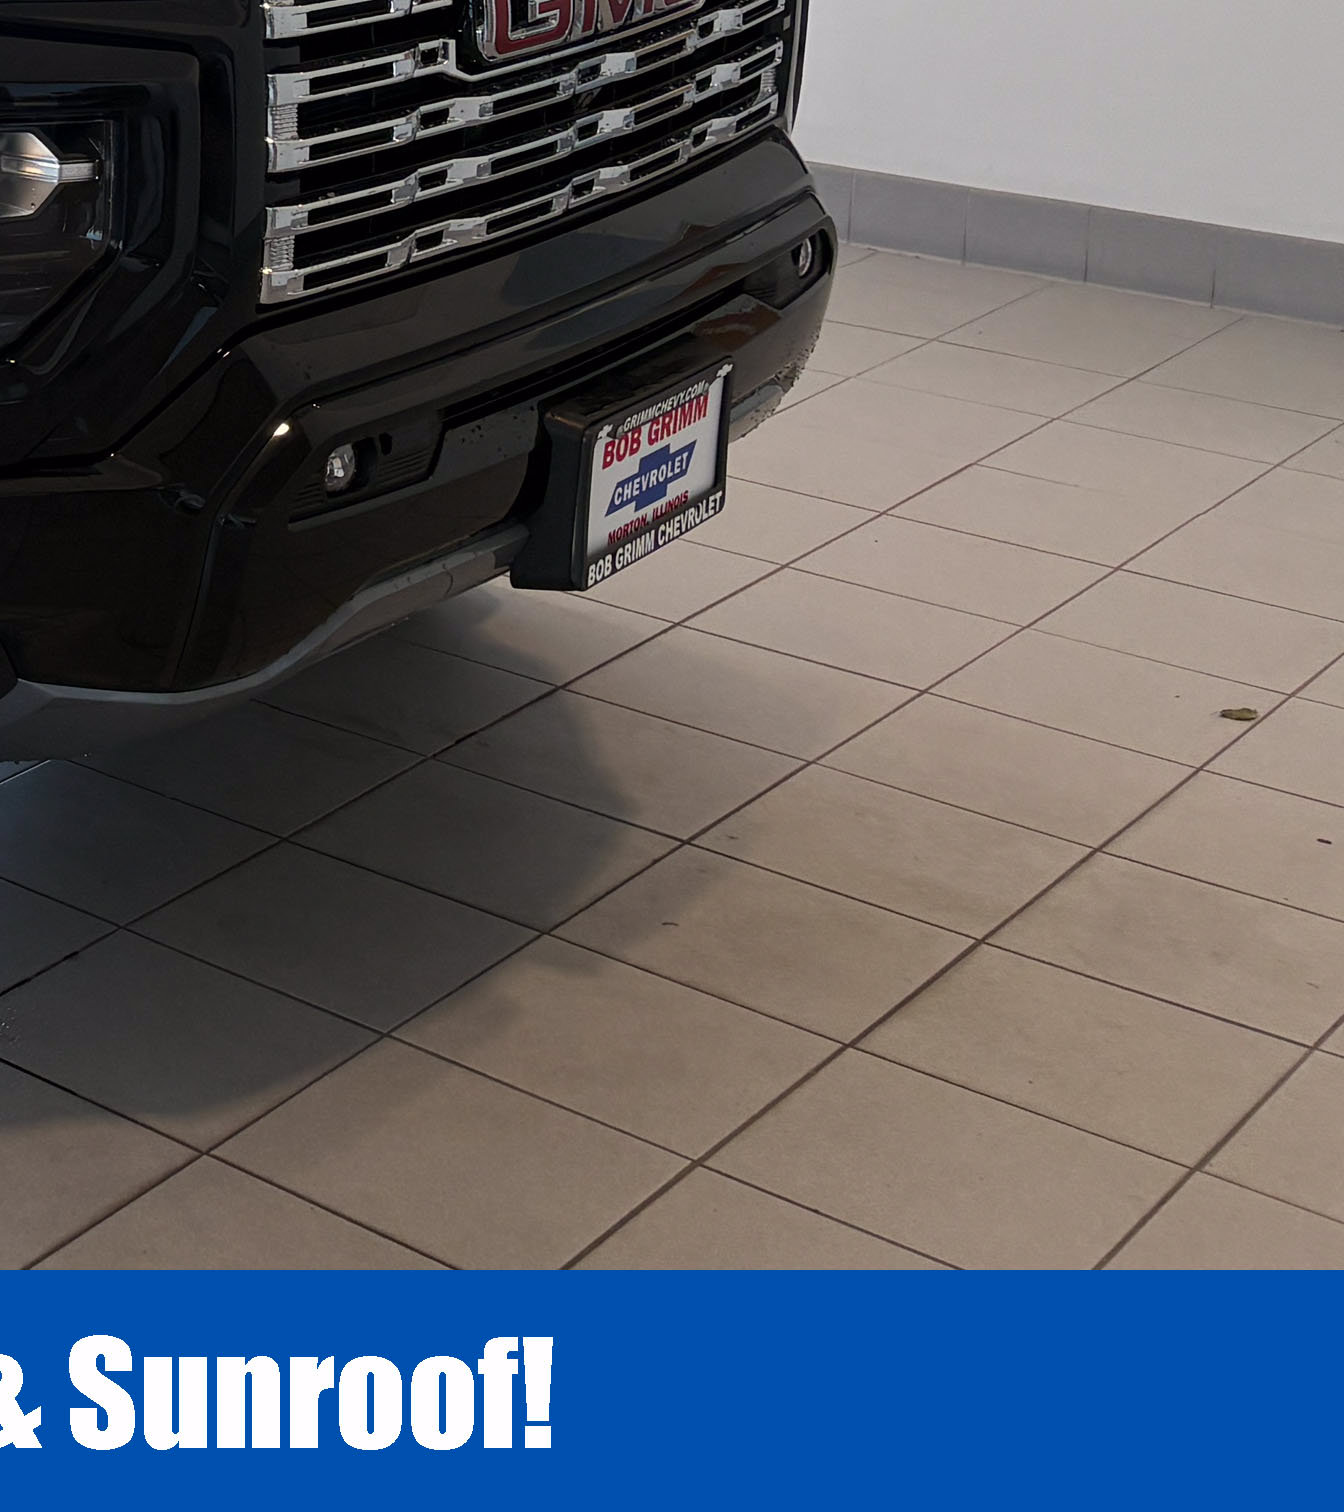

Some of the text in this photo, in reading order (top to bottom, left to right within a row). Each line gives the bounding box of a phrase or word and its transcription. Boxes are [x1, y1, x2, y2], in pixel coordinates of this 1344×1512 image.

[602, 392, 709, 469] BOB GRIMM
[624, 380, 705, 431] GRIMMCHEVY.COM
[614, 451, 690, 505] CHEVROLET
[588, 491, 723, 587] BOB GRIMM CHEVROLET
[607, 490, 689, 545] MORTON, ILLINOIS
